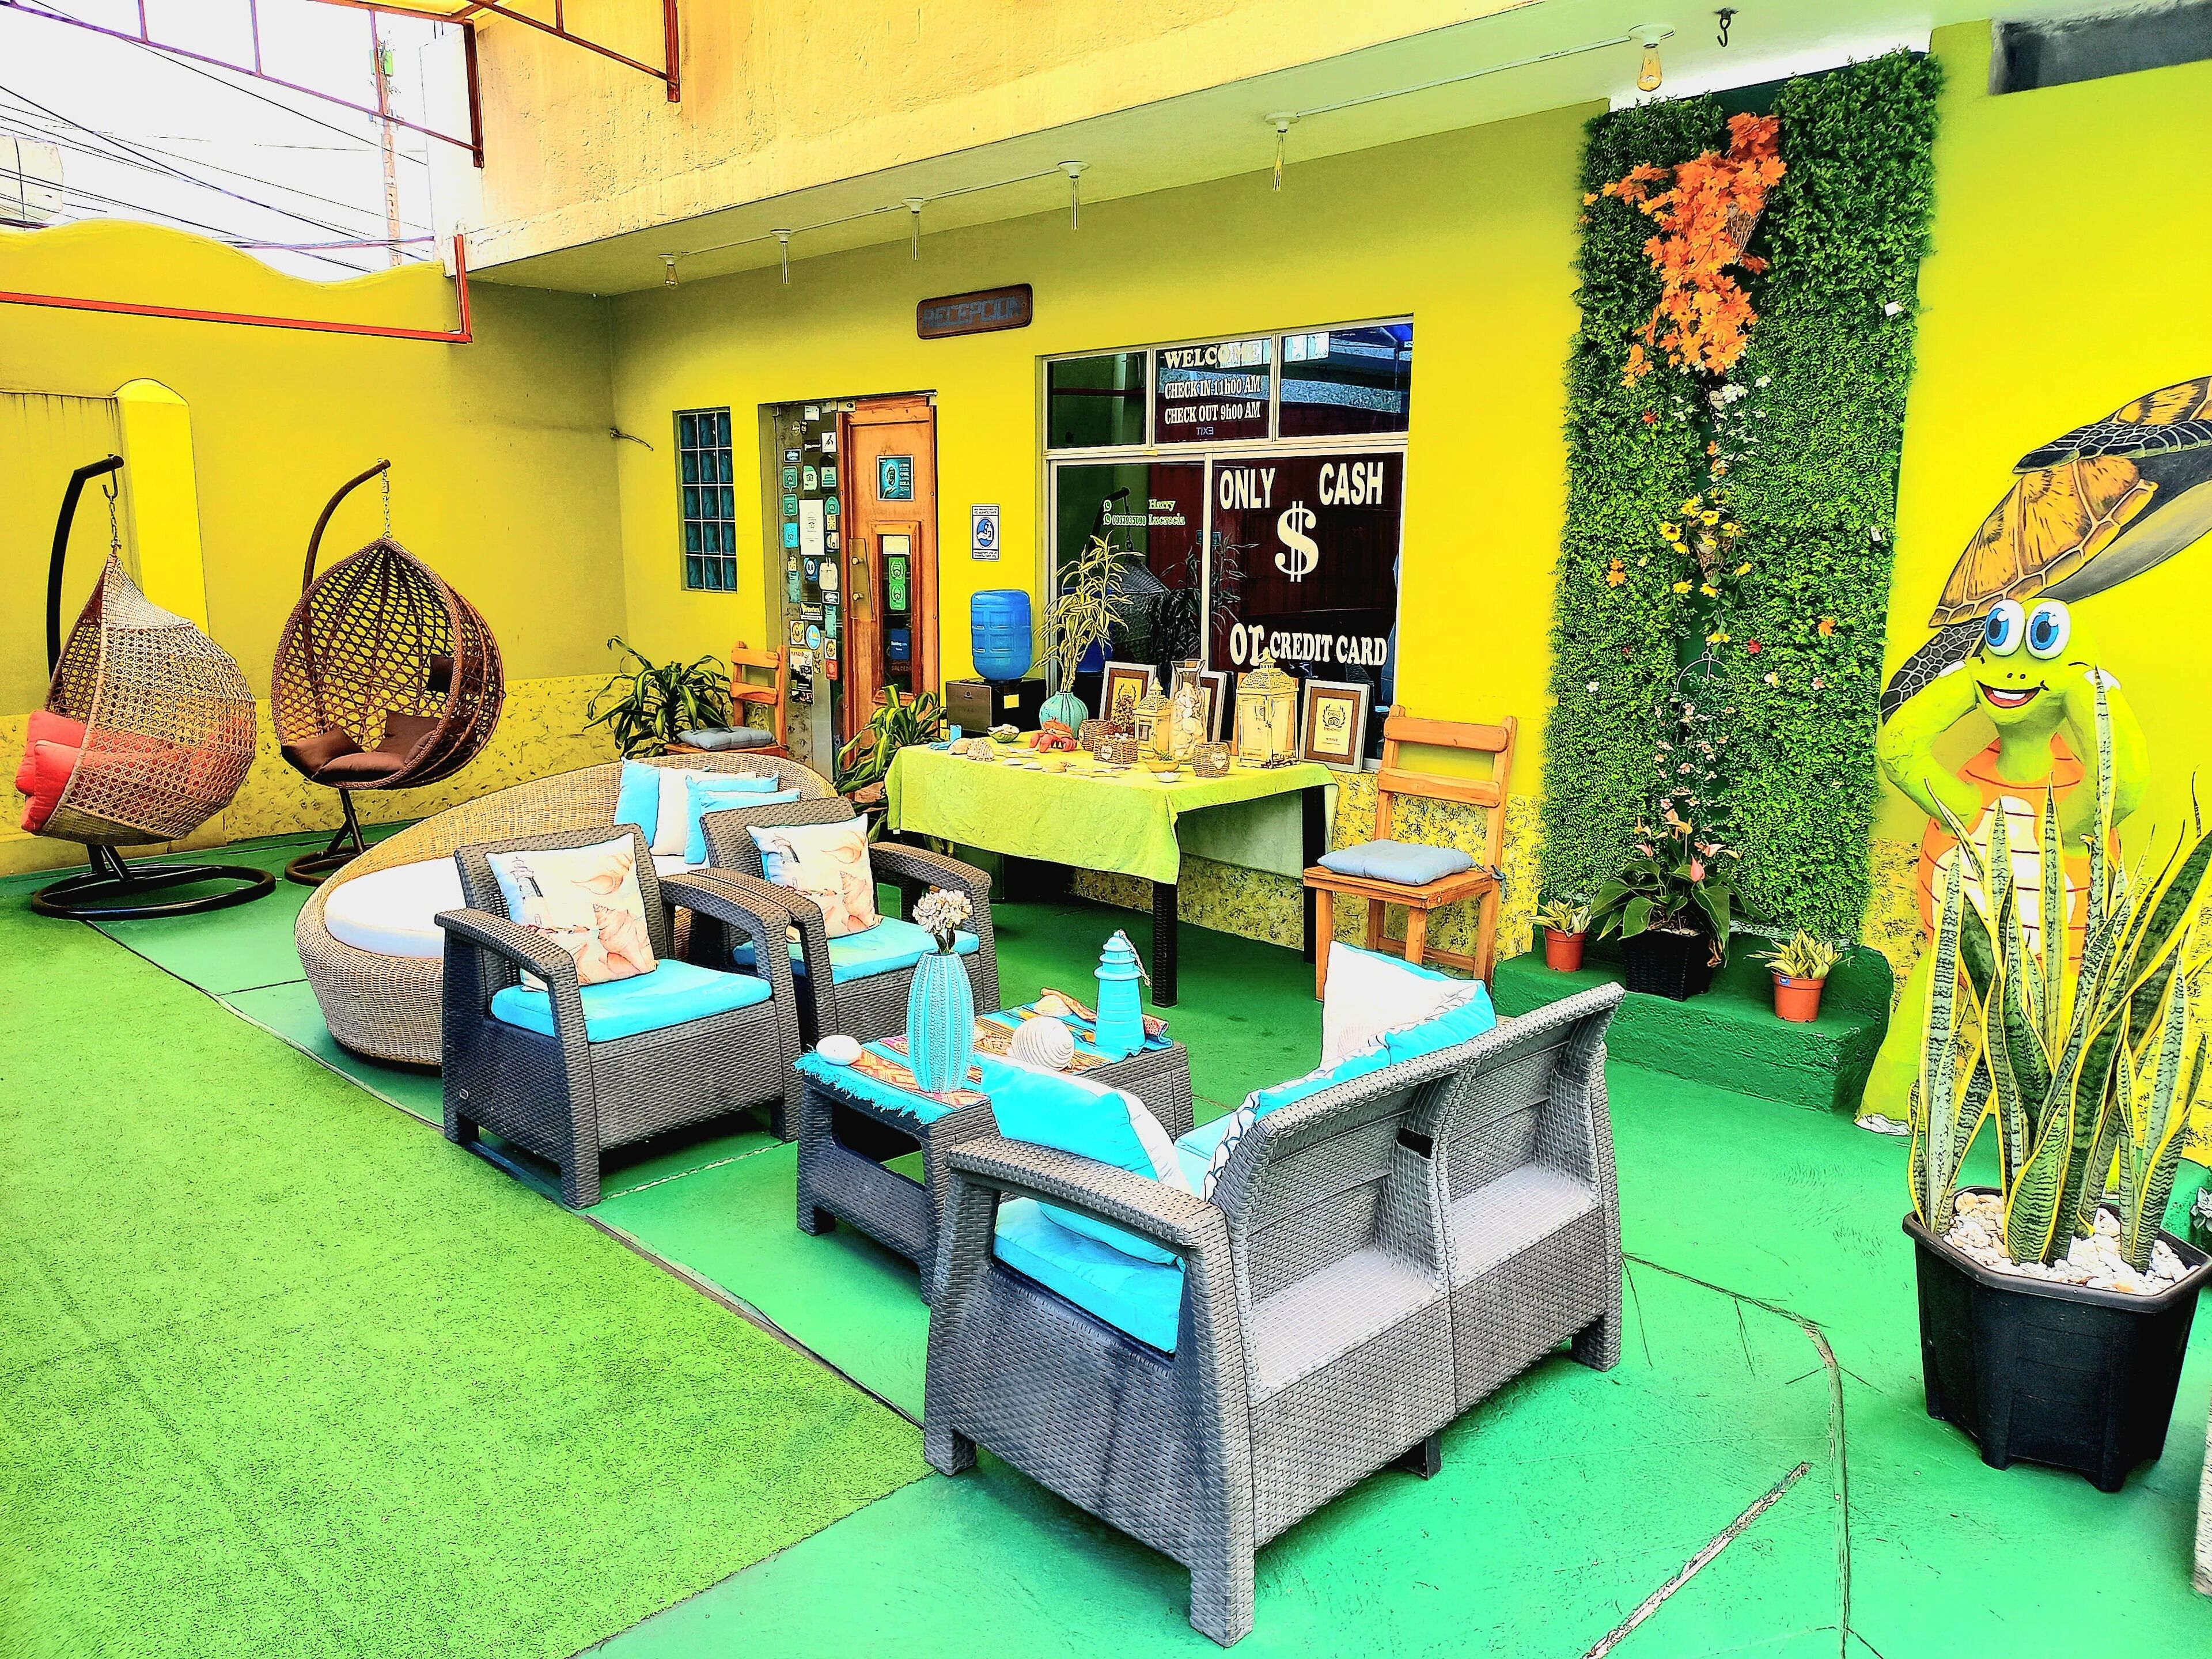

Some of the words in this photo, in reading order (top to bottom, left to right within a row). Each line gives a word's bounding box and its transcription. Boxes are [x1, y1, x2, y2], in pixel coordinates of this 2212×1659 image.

[1165, 342, 1260, 369] WELCOME
[1165, 381, 1198, 399] CHECK
[1244, 376, 1262, 393] AM
[1165, 407, 1197, 425] CHECK
[1199, 404, 1219, 422] OUT
[1221, 404, 1243, 421] 9h00
[1244, 402, 1262, 419] AM
[1219, 467, 1276, 510] ONLY
[1319, 461, 1384, 505] CASH
[1148, 499, 1176, 512] Harry
[1270, 631, 1333, 662] CREDIT
[1336, 635, 1388, 666] CARD
